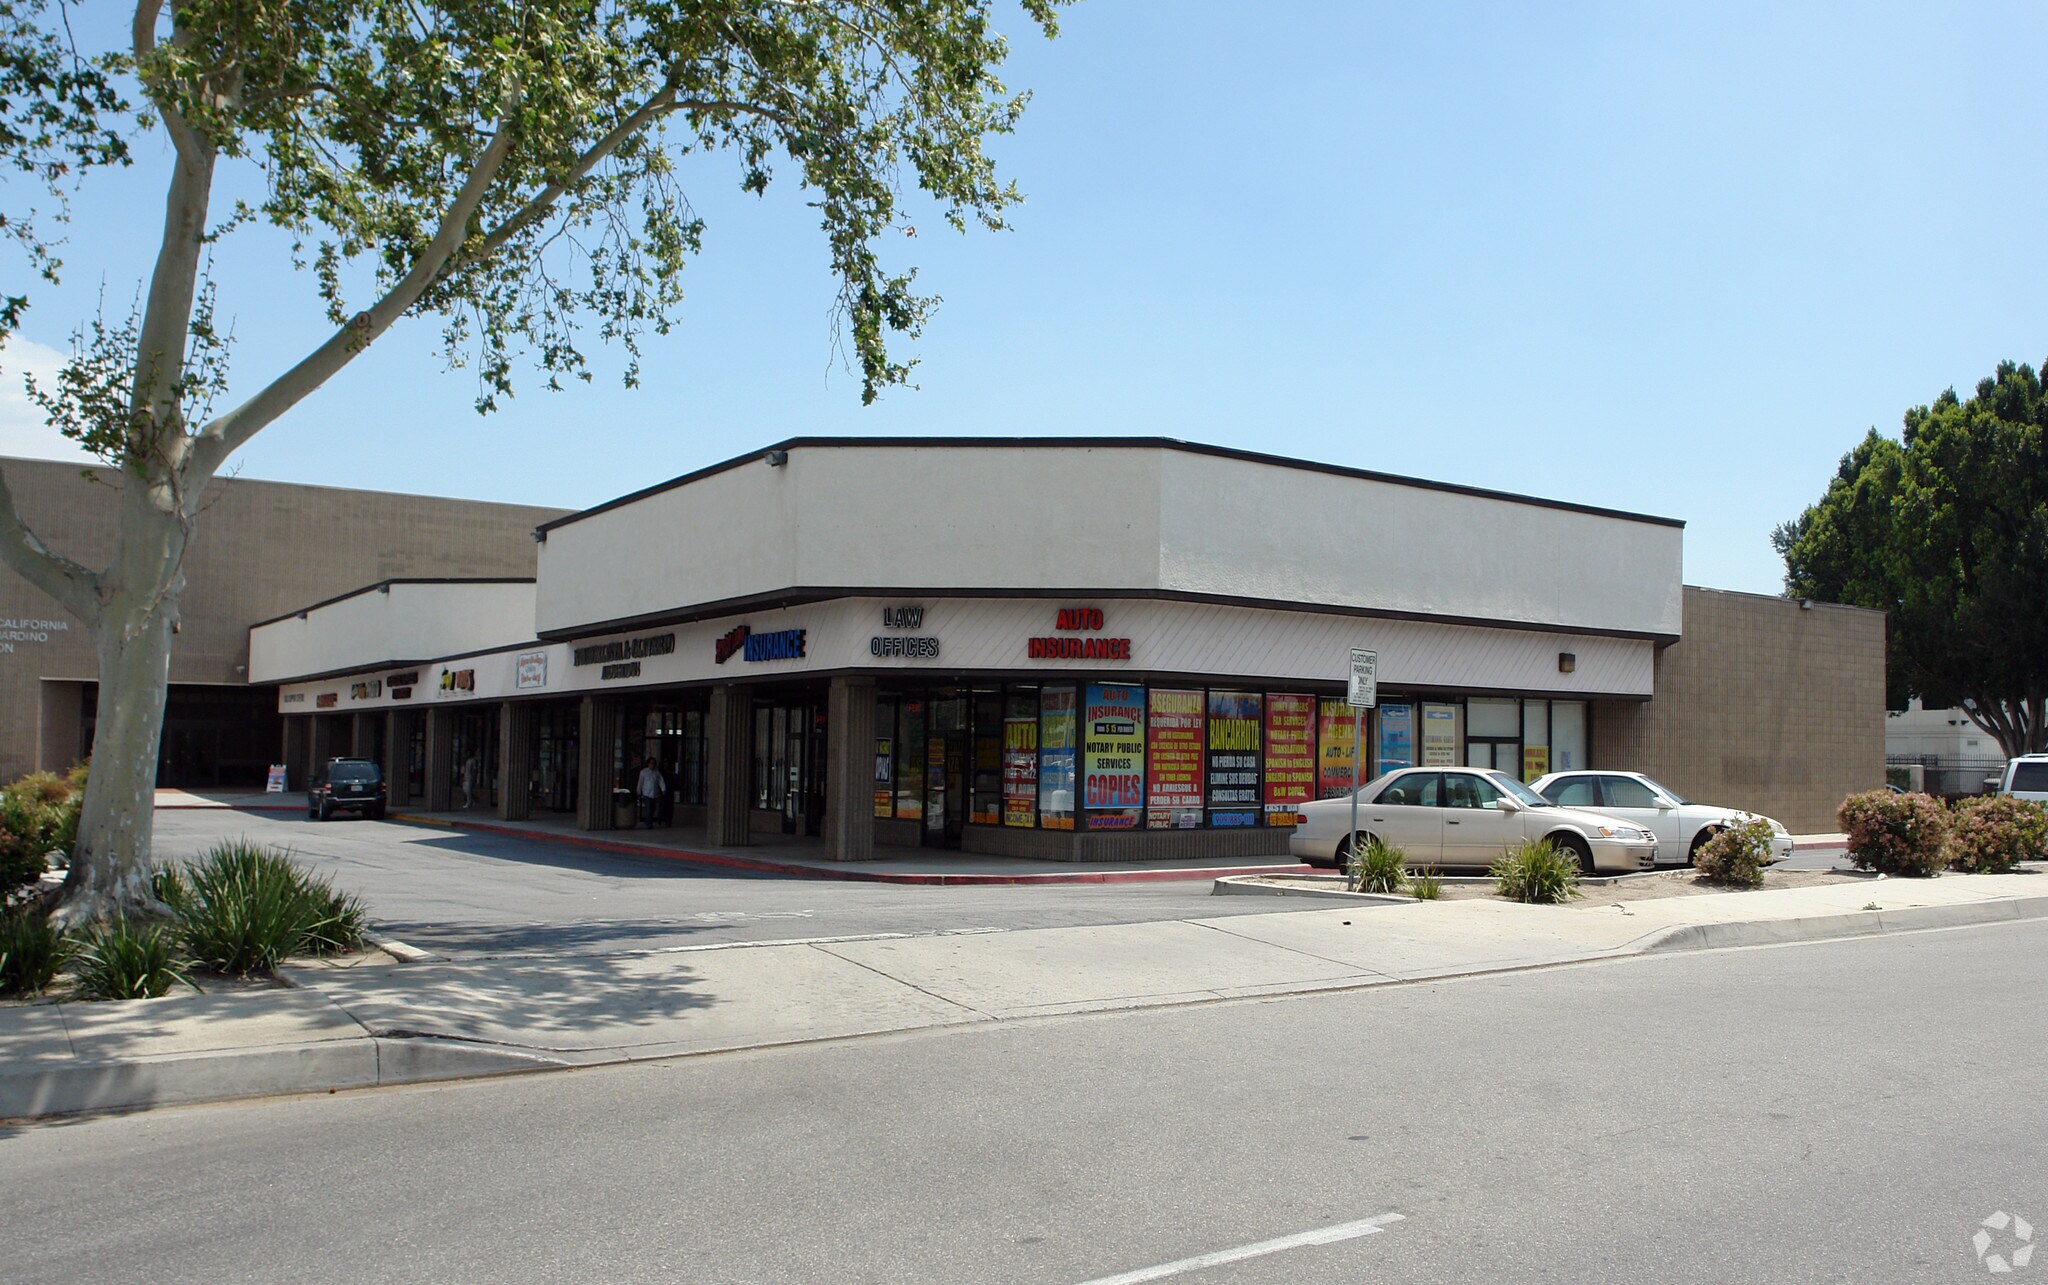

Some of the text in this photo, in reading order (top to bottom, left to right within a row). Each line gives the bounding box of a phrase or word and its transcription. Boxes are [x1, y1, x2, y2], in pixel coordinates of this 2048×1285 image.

[884, 607, 924, 629] LAW
[1056, 608, 1104, 630] AUTO
[0, 631, 48, 642] ARDINO
[744, 629, 806, 662] INSURANCE
[870, 637, 940, 658] OFFICES
[1028, 638, 1131, 660] INSURANCE
[1352, 653, 1376, 664] CUSTOMER
[1353, 664, 1373, 675] PARKING
[1103, 690, 1128, 701] AUTO
[1151, 694, 1201, 714] ASEGURANZA
[1321, 702, 1364, 718] INSURANE
[1088, 705, 1142, 724] INSURANCE
[1150, 717, 1202, 728] REQUERIDA POR LEY
[1005, 722, 1037, 750] AUTO
[1210, 719, 1260, 750] BANCARROTA
[1086, 742, 1142, 754] NOTARY PUBLIC
[1272, 744, 1307, 754] TRANSLATIONS
[1326, 746, 1342, 758] AUTO
[1346, 747, 1356, 758] LIF
[1097, 758, 1131, 770] SERVICES
[1293, 758, 1313, 768] ENGLISH
[1087, 774, 1140, 805] COPIES
[1153, 784, 1161, 792] NO
[1193, 784, 1198, 792] A
[1150, 796, 1170, 804] PERDER
[1172, 796, 1180, 804] SU
[1090, 816, 1134, 827] INSURANCE
[1149, 812, 1170, 820] NOTARY
[1149, 820, 1169, 828] PUBLIC
